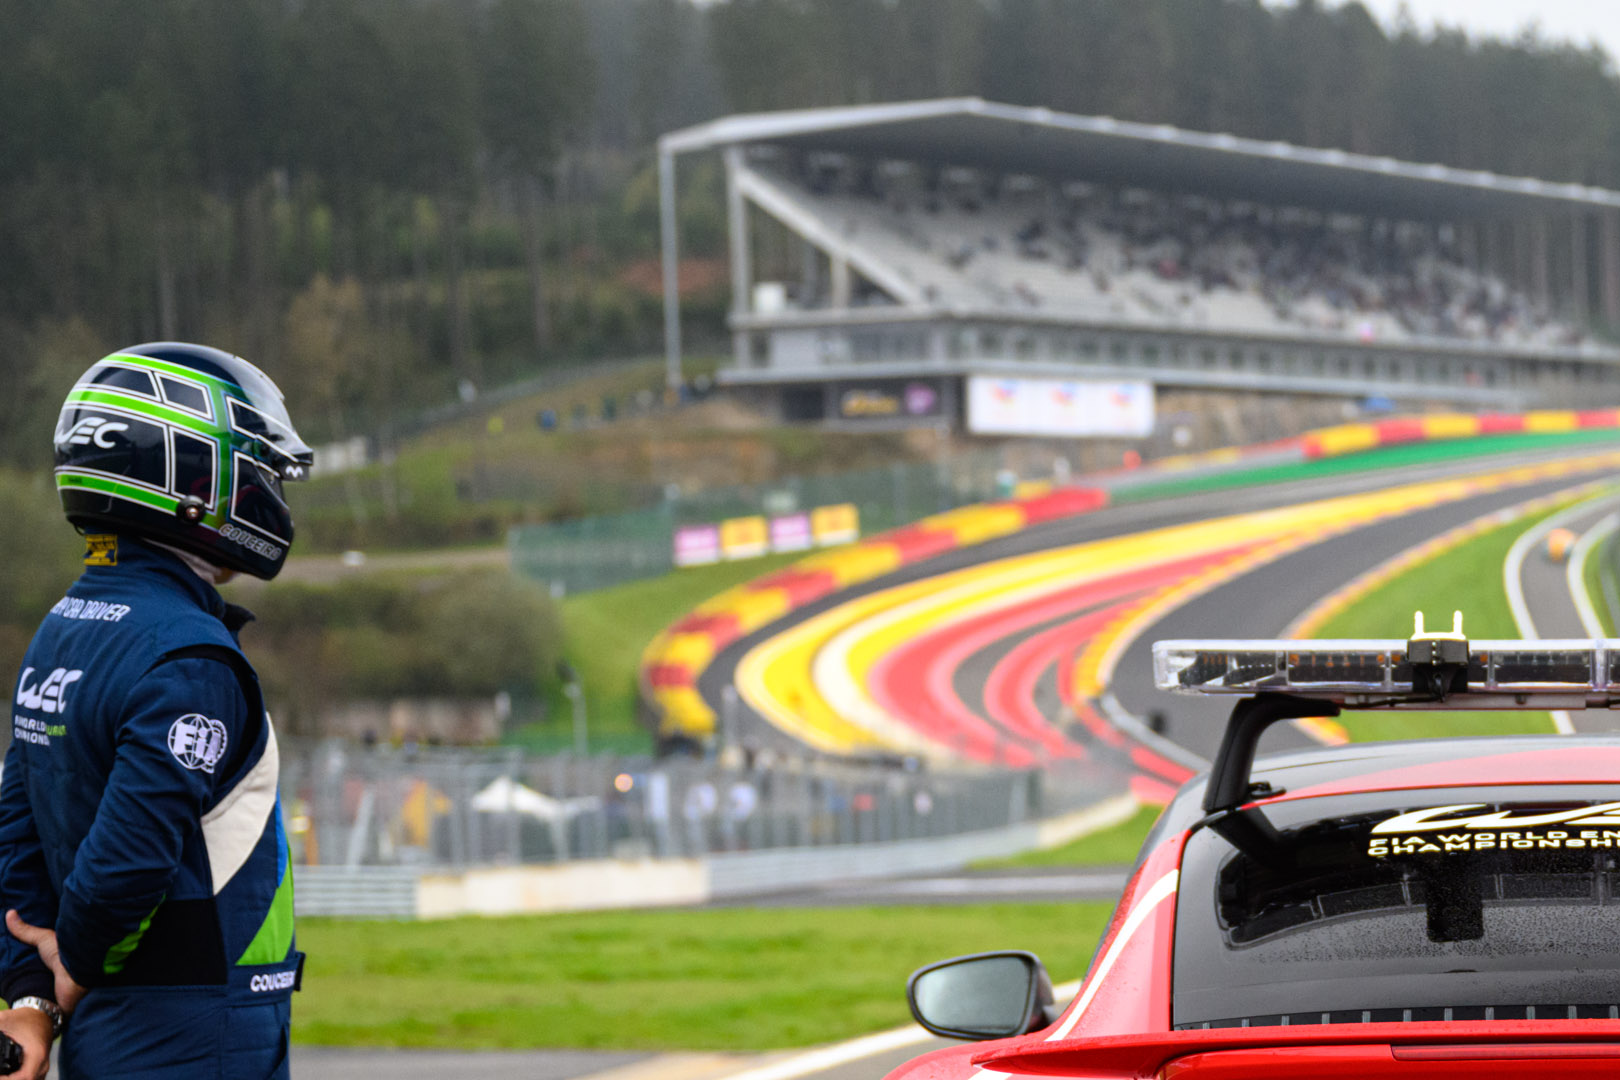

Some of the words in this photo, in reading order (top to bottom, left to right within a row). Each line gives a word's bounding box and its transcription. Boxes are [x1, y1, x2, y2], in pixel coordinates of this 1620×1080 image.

[78, 600, 131, 622] DRIVER
[16, 667, 83, 714] WEC
[1369, 836, 1426, 848] FIA
[1437, 830, 1569, 842] WORLD
